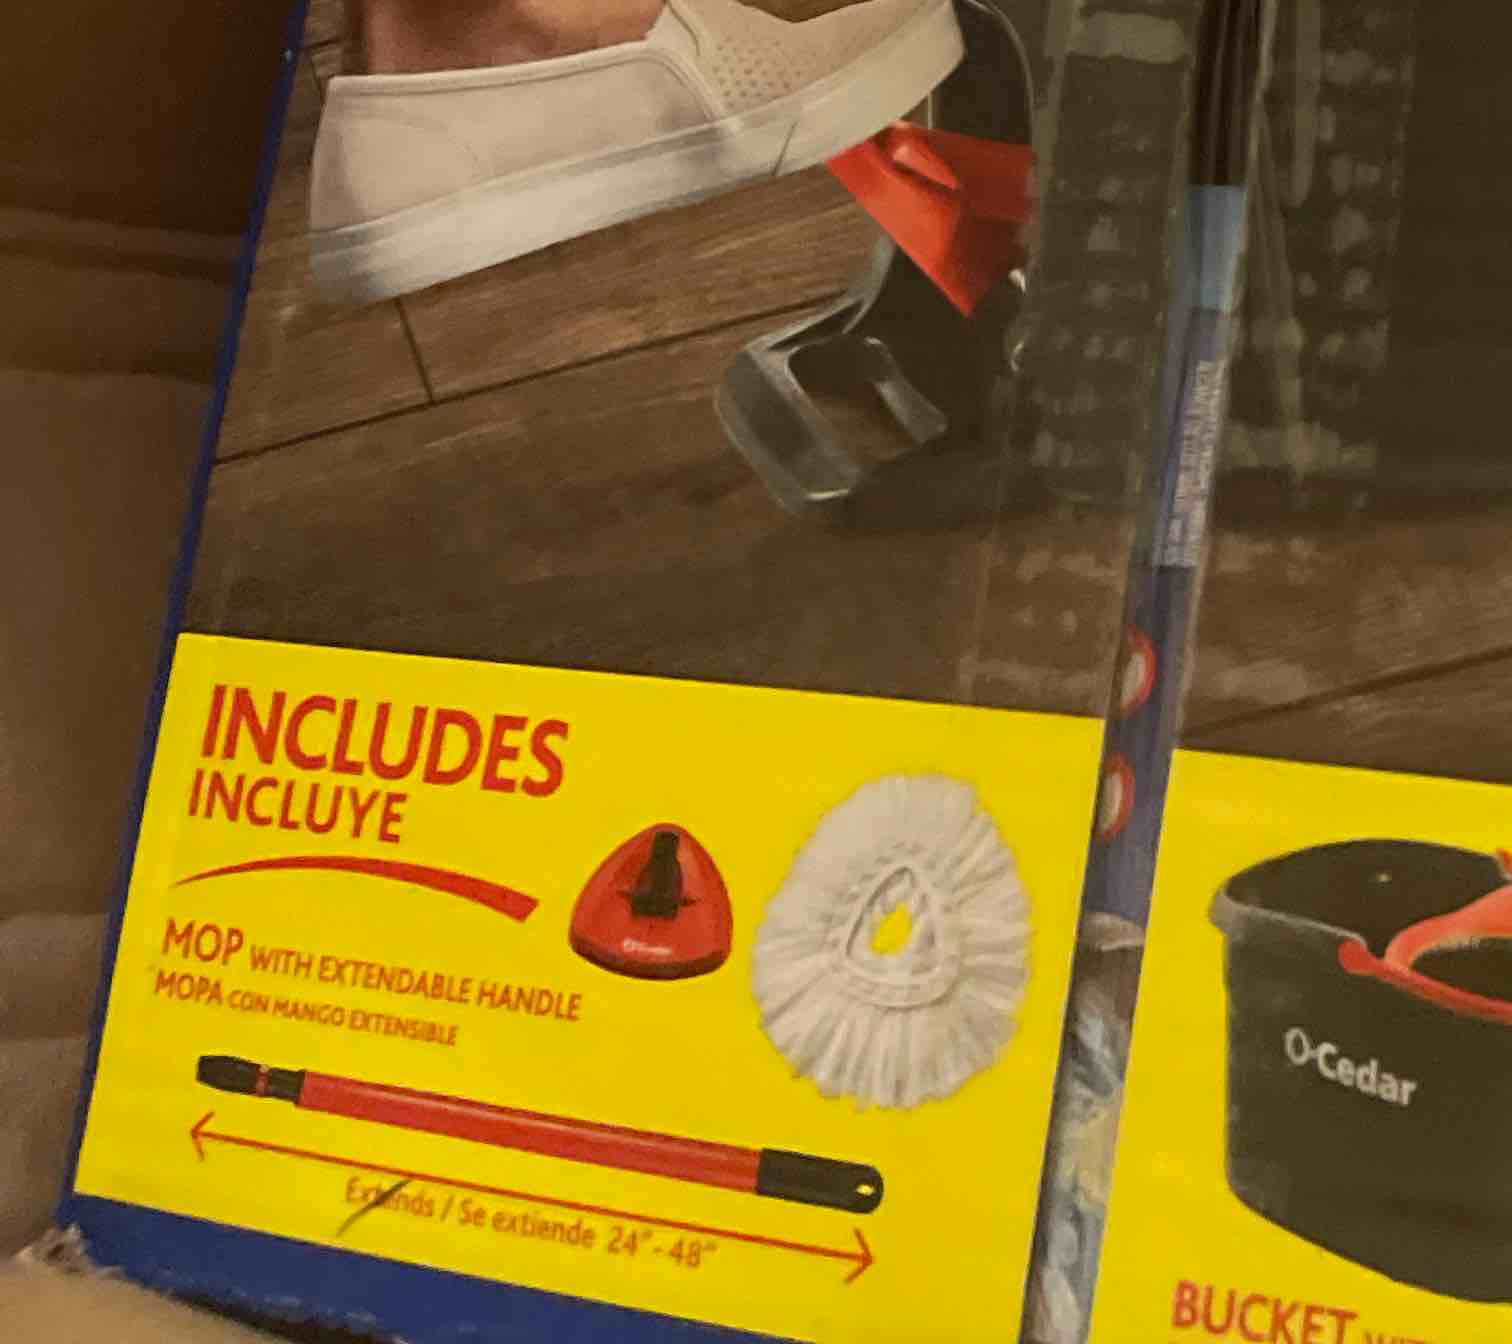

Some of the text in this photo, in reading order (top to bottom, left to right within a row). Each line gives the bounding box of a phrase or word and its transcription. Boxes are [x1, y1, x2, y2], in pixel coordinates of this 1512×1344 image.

[201, 684, 570, 798] INCLUDES
[187, 768, 409, 844] INCLUYE
[154, 970, 460, 1048] MOPA CON MANGO EXTENSIBLE
[161, 917, 584, 1023] MOP WITH EXTENDABLE HANDLE
[1282, 1024, 1418, 1108] O-Cedar
[458, 1199, 486, 1228] Se
[491, 1210, 596, 1250] extiende
[1171, 1279, 1359, 1344] BUCKET
